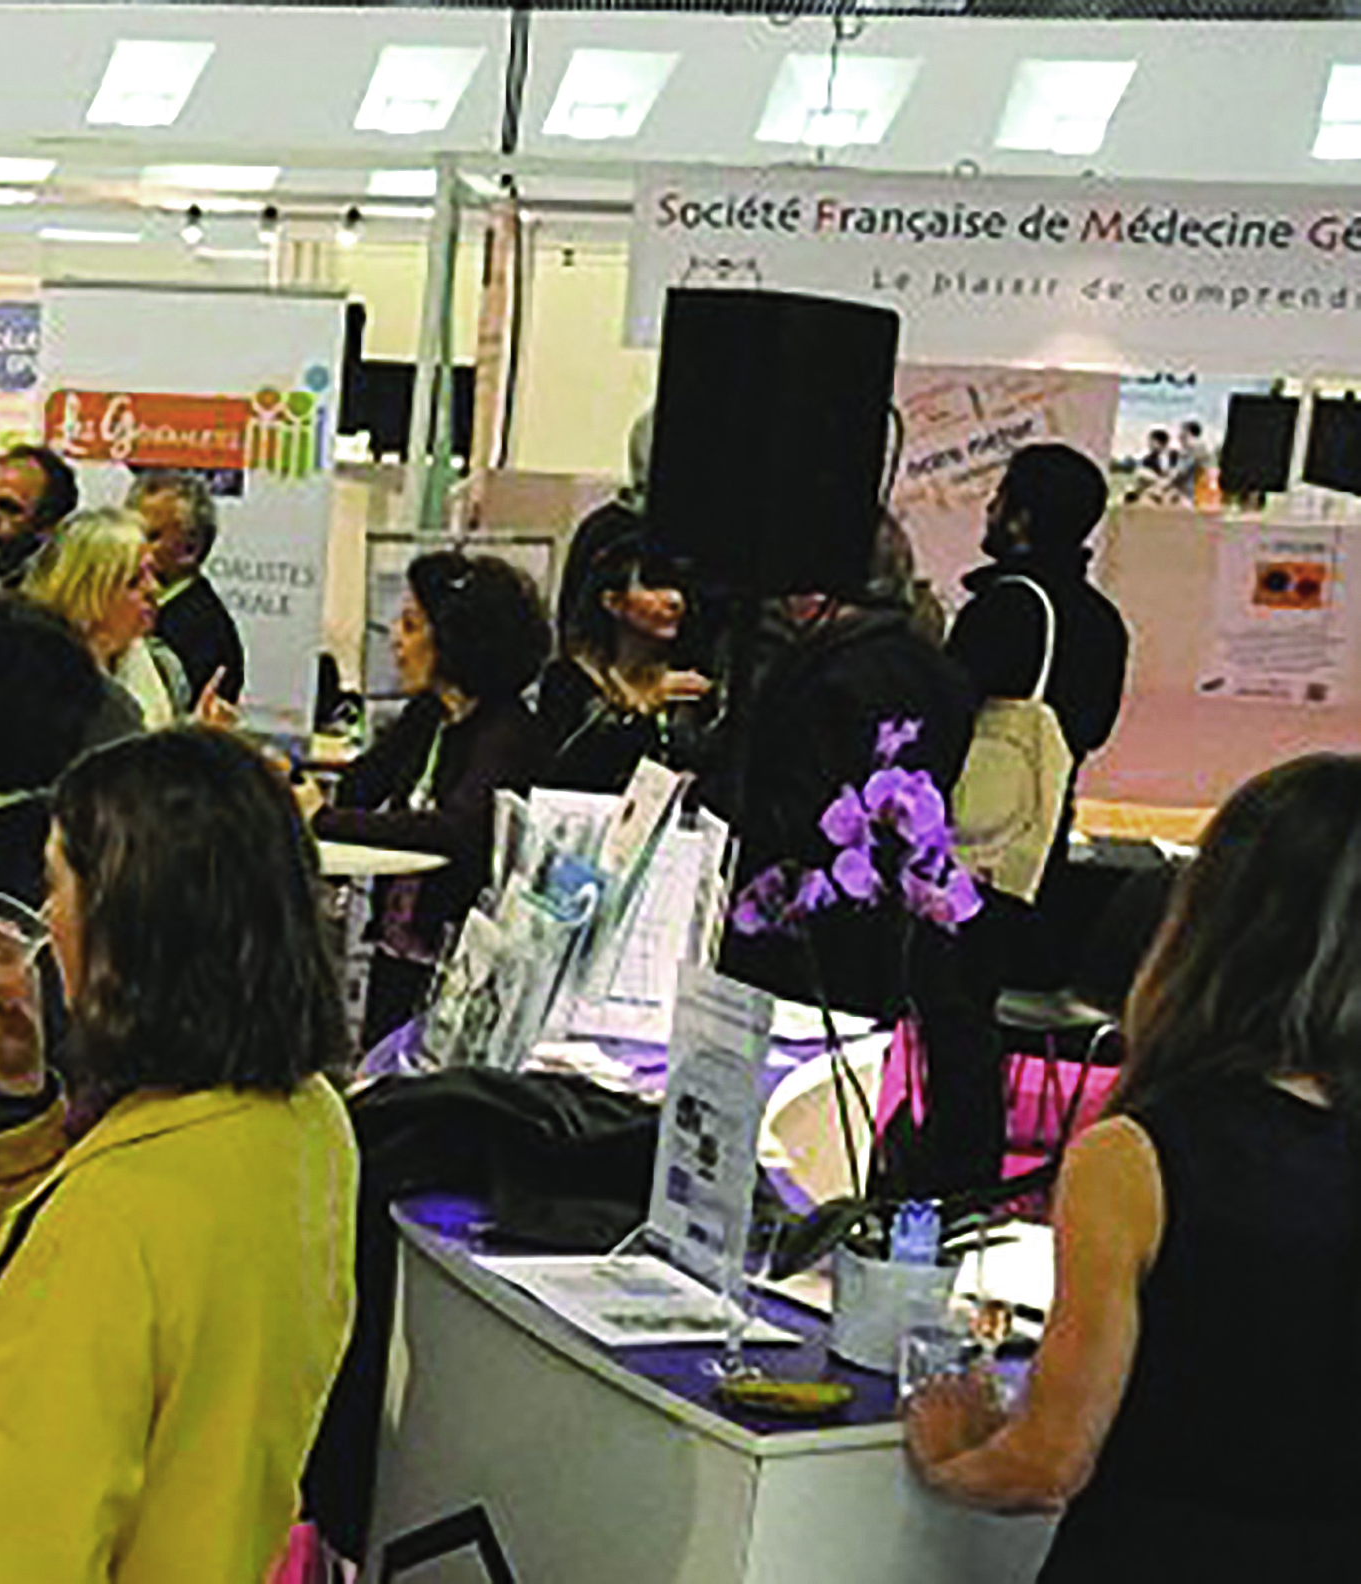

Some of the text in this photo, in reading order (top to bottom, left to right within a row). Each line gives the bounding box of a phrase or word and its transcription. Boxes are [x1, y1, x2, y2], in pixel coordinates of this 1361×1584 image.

[657, 191, 802, 233] Société
[812, 197, 1007, 242] Française
[1018, 204, 1070, 242] de
[1080, 206, 1294, 248] Médecine
[872, 265, 911, 291] Le
